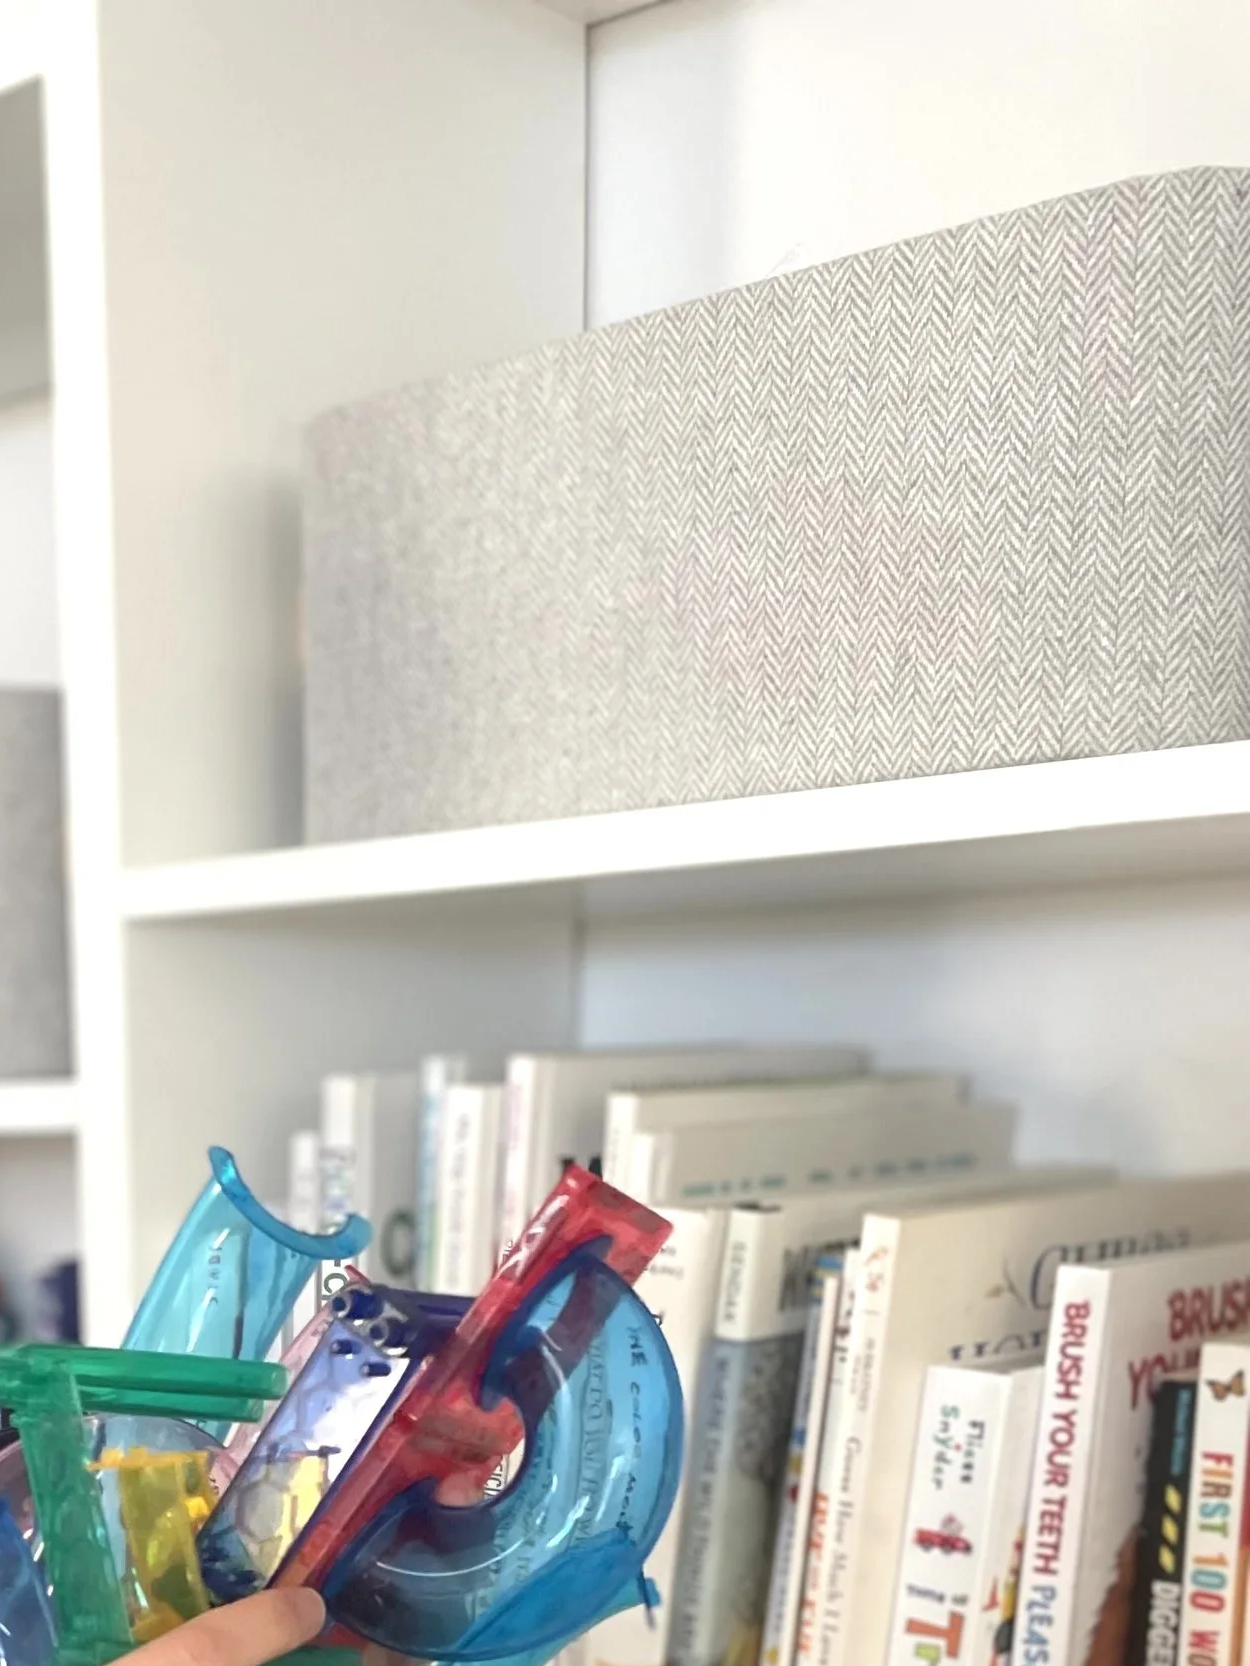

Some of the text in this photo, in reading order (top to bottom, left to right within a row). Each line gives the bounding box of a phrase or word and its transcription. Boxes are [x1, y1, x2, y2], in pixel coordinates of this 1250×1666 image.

[1054, 1299, 1091, 1400] BRUSH
[1166, 1276, 1250, 1343] BRUS
[931, 1403, 961, 1490] Snyder
[1043, 1408, 1078, 1489] YOUR
[1197, 1450, 1234, 1539] FIRST
[1033, 1495, 1066, 1577] TEETH
[1189, 1553, 1229, 1613] 100
